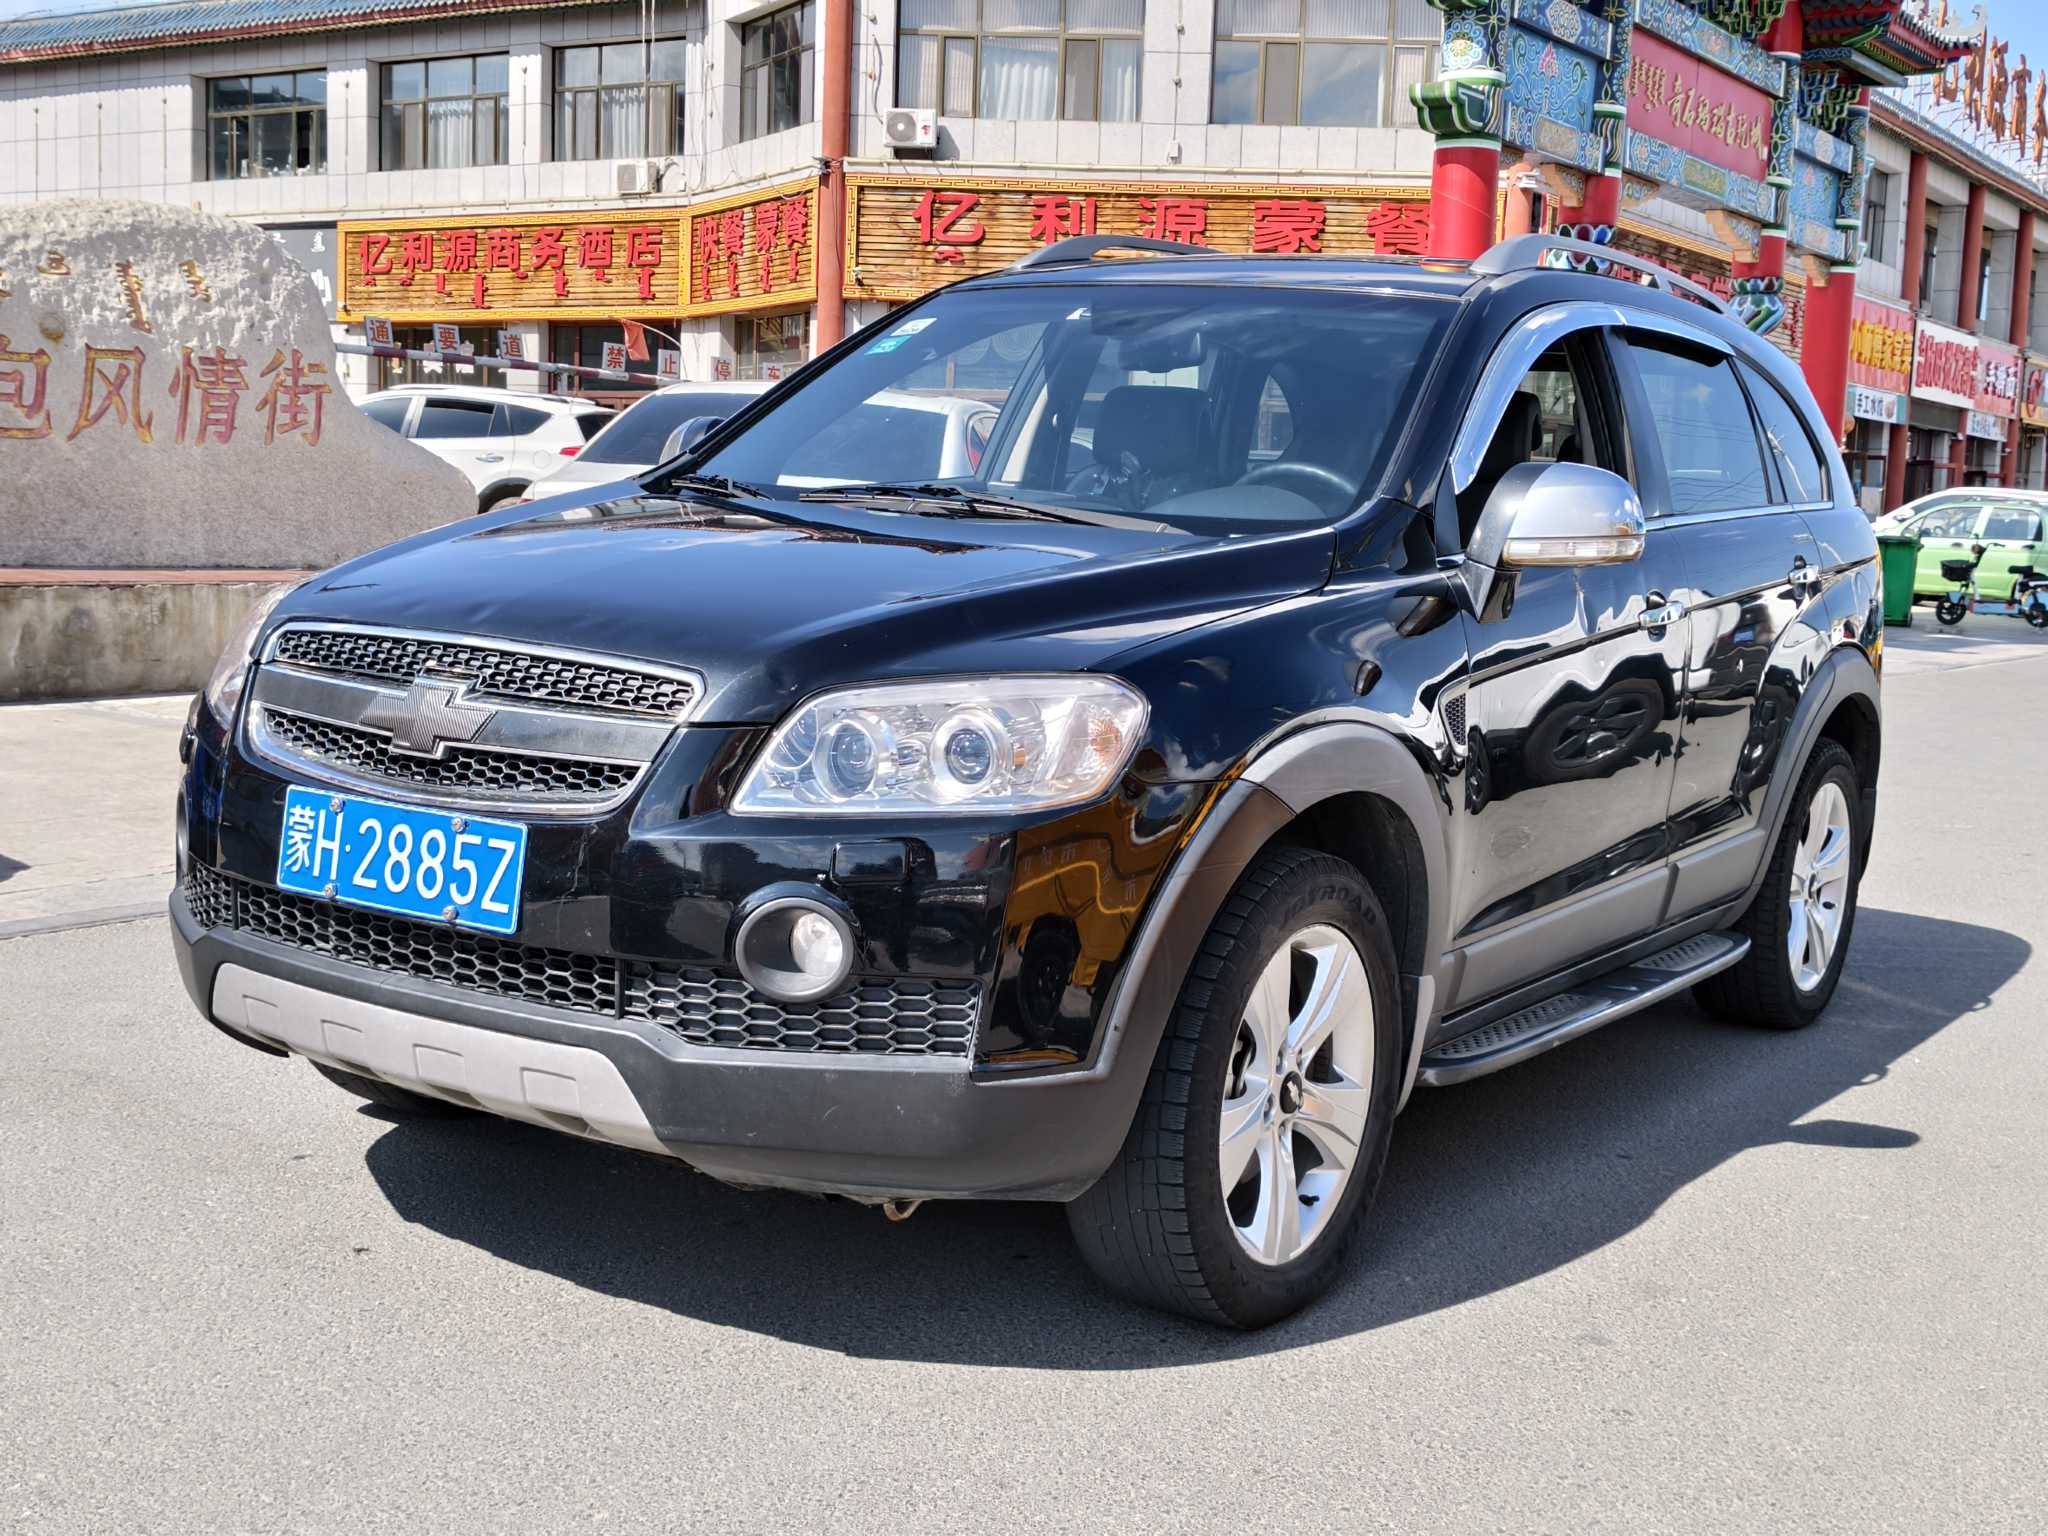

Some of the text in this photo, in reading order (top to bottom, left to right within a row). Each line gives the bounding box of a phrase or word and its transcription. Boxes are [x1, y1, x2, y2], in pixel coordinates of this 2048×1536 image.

[360, 226, 663, 274] 亿利源商务酒店
